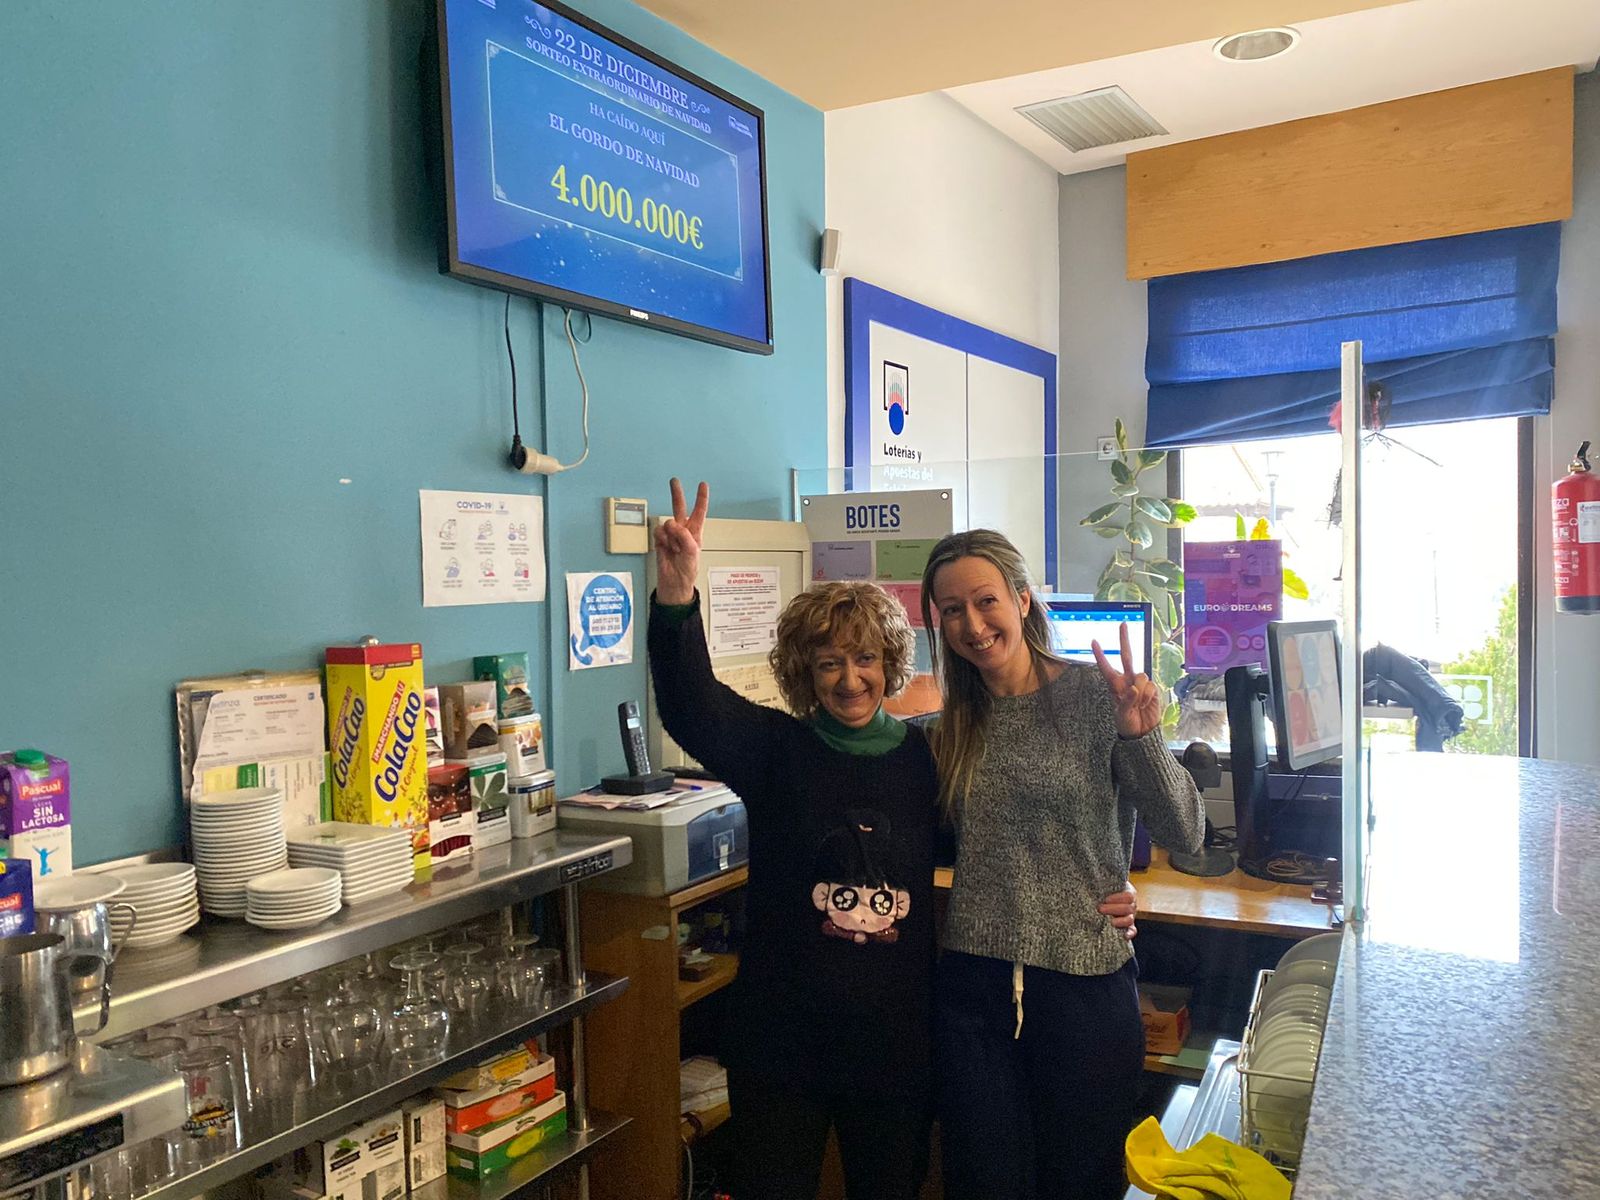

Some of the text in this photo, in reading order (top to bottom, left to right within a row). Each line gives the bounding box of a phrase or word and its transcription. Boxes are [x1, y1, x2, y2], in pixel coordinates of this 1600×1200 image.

[526, 36, 570, 67] SORTEO
[572, 59, 660, 109] EXTRAORDINARIO
[661, 102, 674, 116] DE
[674, 106, 711, 135] NAVIDAD
[555, 28, 688, 109] 22 DE DICIEMBRE
[589, 102, 665, 146] HA CAÍDO AQUÍ
[549, 113, 699, 188] EL GORDO DE NAVIDAD
[551, 164, 703, 249] 4.000.000€
[917, 451, 922, 463] y
[456, 500, 492, 509] COVID-19
[846, 504, 900, 528] BOTES
[1193, 603, 1273, 612] EURO DREAMS
[333, 697, 364, 789] ColaCao
[375, 692, 421, 802] ColaCao
[22, 780, 61, 796] Pascual
[21, 813, 64, 829] LACTOSA
[33, 805, 53, 818] SIN
